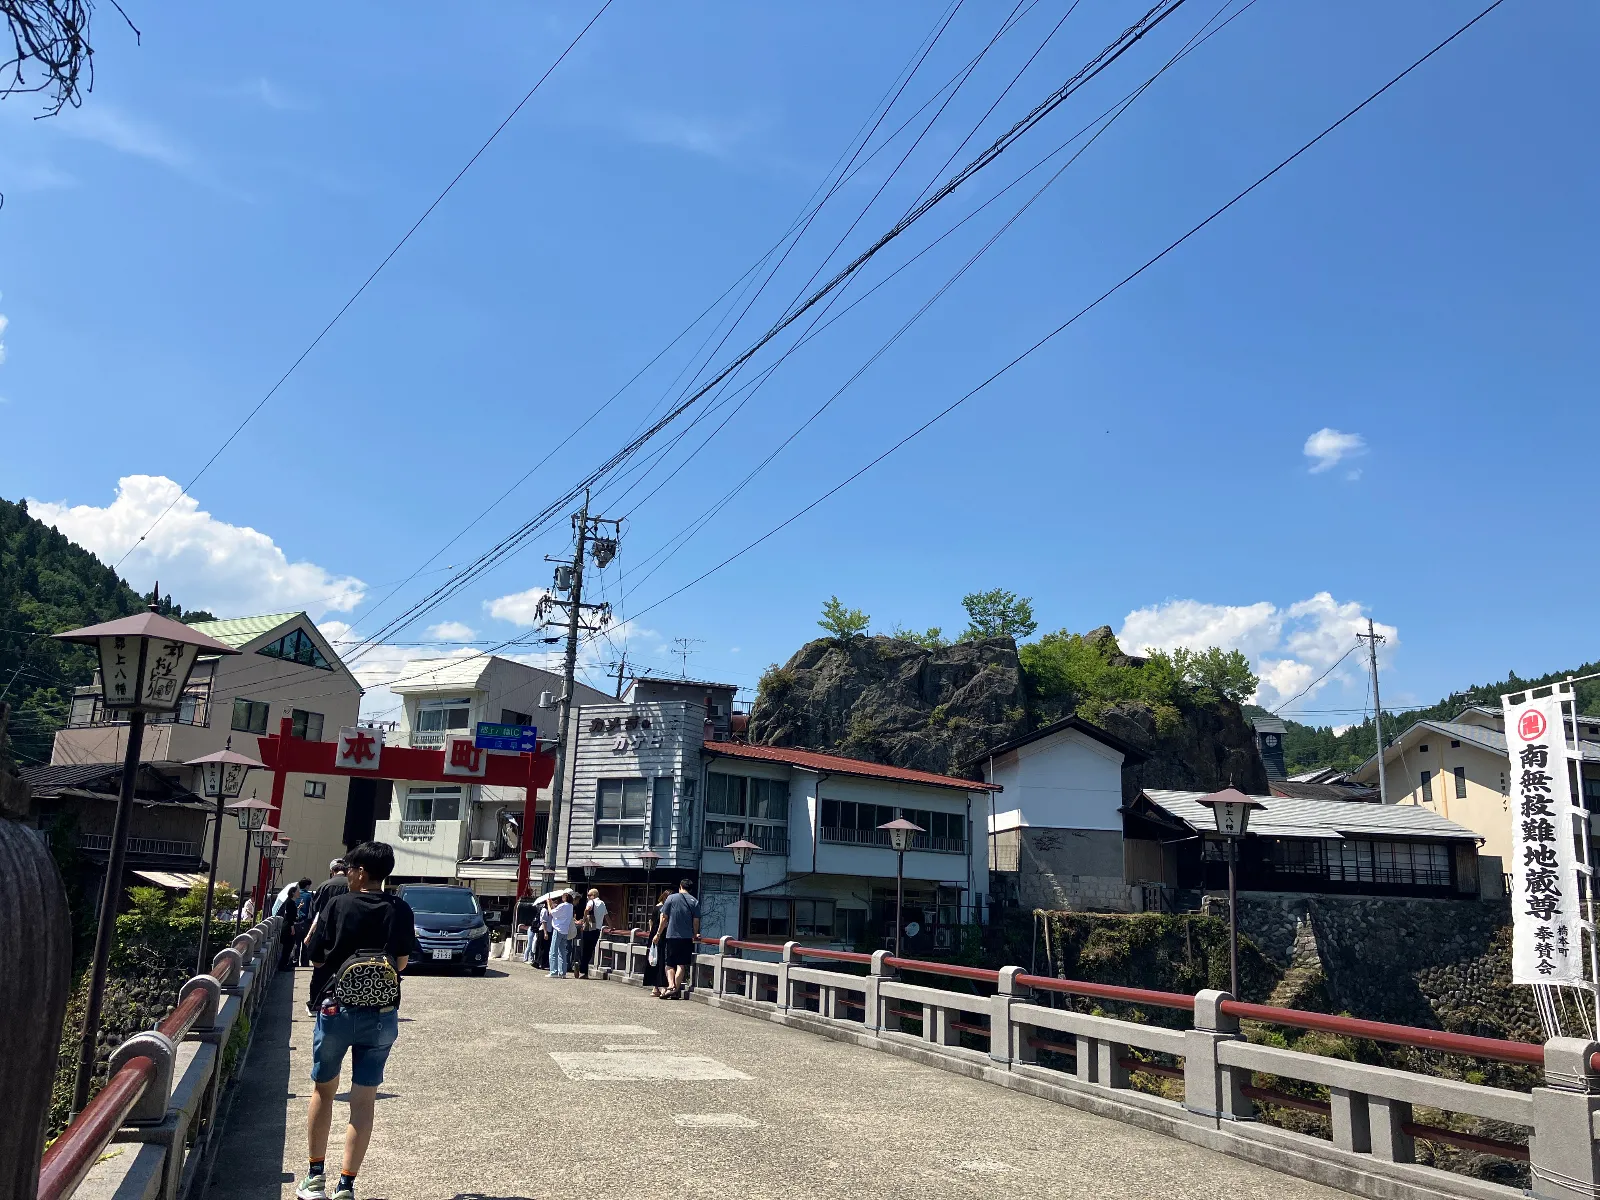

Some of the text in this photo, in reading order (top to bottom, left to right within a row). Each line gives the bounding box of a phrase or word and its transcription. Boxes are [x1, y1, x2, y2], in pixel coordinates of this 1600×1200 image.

[114, 637, 127, 695] 郡上八幡
[1518, 744, 1564, 922] 南無救難地蔵尊
[1533, 925, 1557, 975] 奉賛会
[1557, 925, 1570, 958] 橋本町
